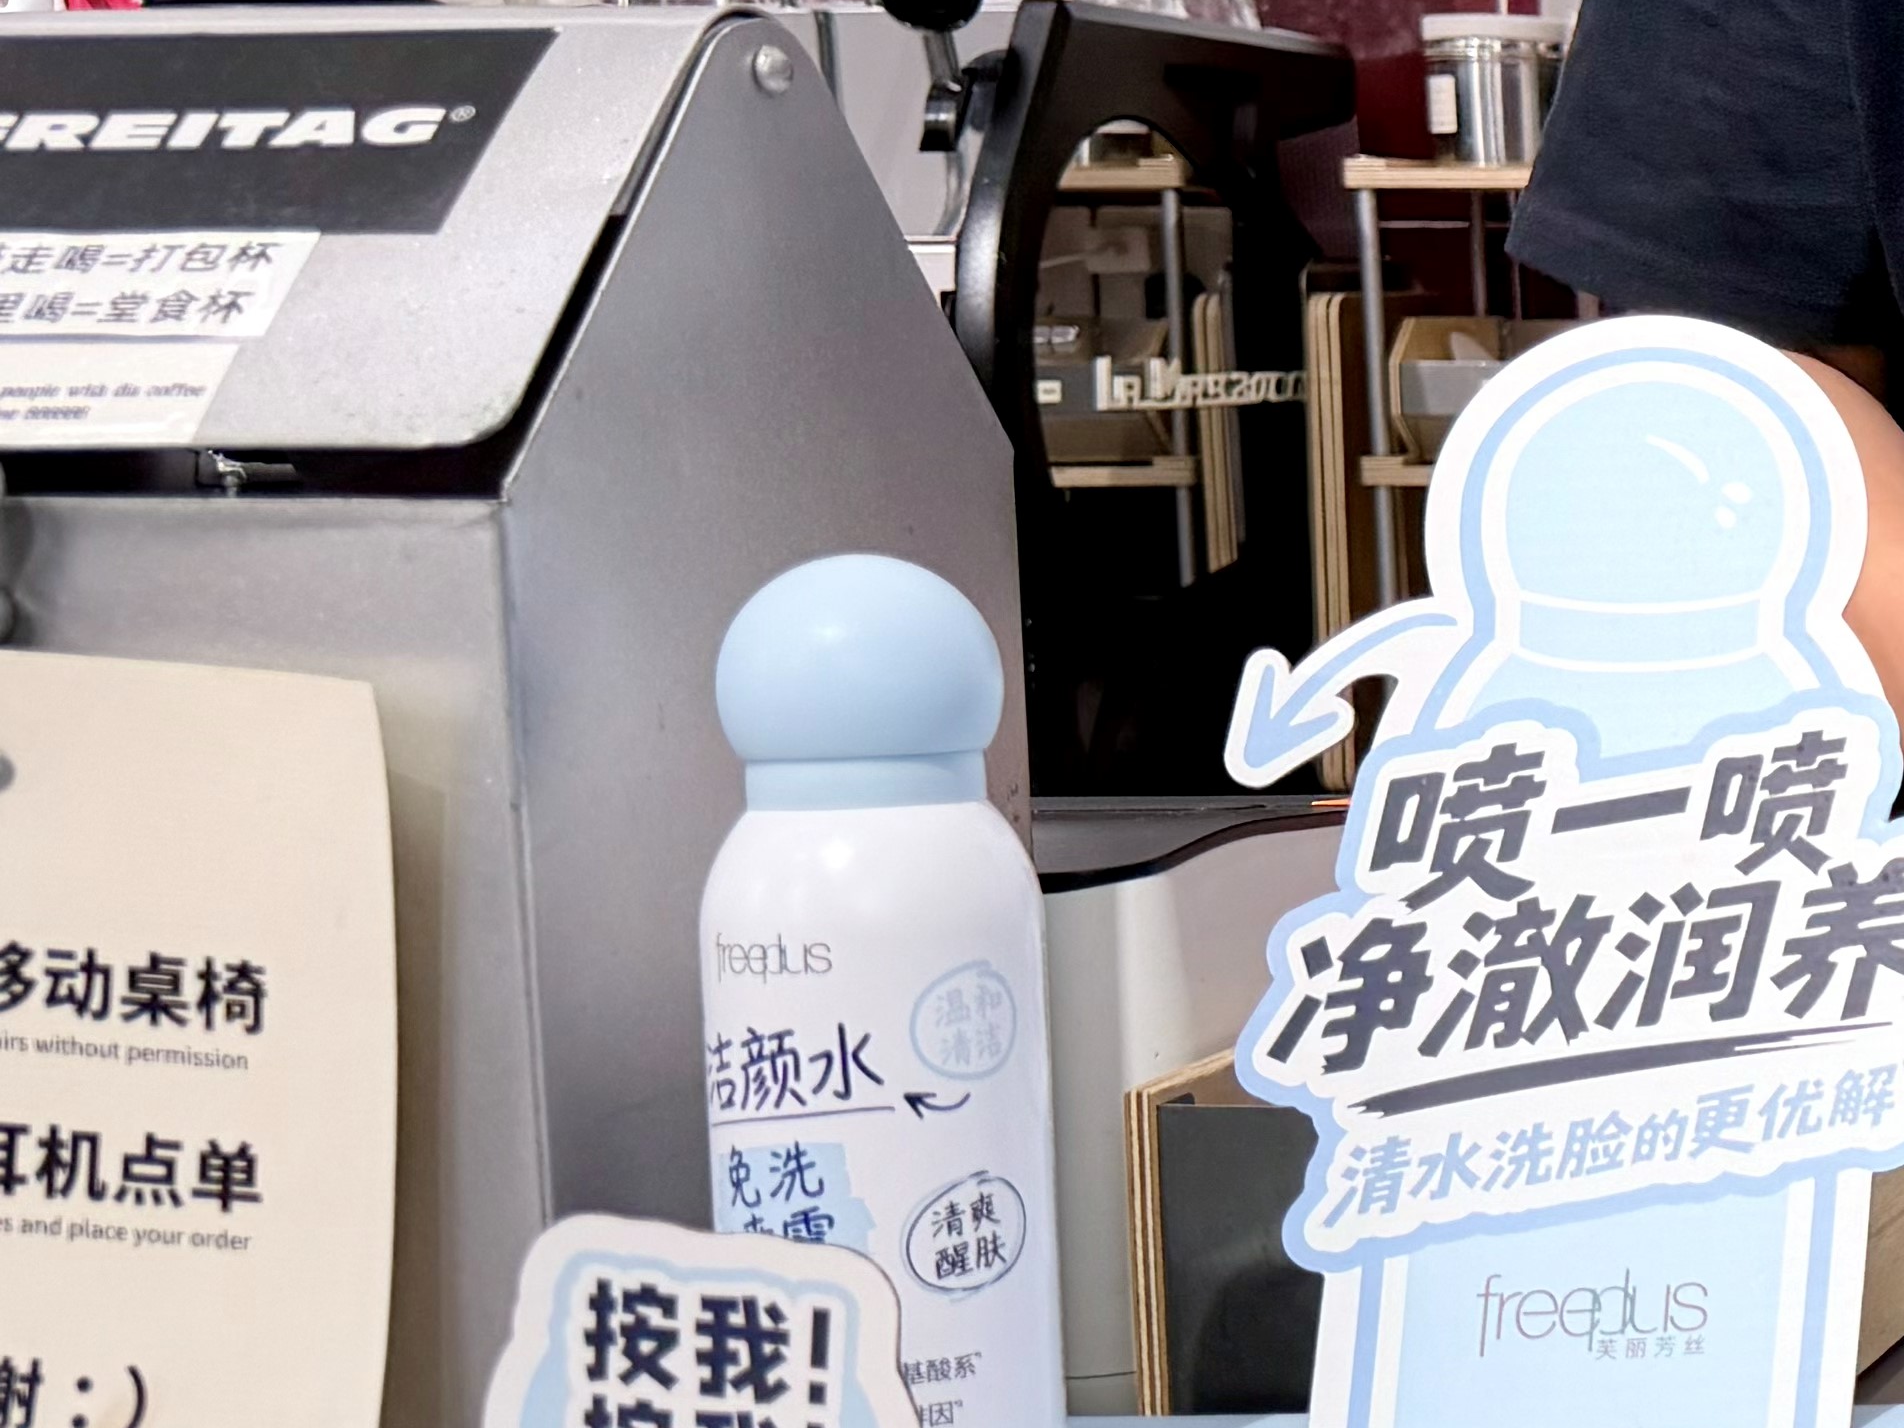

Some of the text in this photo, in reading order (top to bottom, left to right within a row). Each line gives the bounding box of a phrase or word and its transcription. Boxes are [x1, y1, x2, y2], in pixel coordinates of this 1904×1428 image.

[0, 104, 476, 152] REITAG®
[0, 241, 285, 274] 走喝=打包杯
[1367, 730, 1849, 912] 喷一喷
[716, 933, 833, 984] freeplus
[35, 1036, 120, 1059] without
[125, 1046, 249, 1070] permission
[707, 1022, 884, 1111] 洁颜水
[1323, 1061, 1898, 1230] 清水洗脸的更优解
[728, 1140, 825, 1208] 免洗
[21, 1215, 62, 1235] and
[66, 1217, 128, 1242] place
[133, 1227, 183, 1247] your
[189, 1229, 252, 1251] order
[932, 1192, 1000, 1238] 清爽
[935, 1232, 1007, 1281] 醒肤
[1477, 1268, 1708, 1357] freeplus
[582, 1277, 831, 1405] 按我！
[1596, 1335, 1705, 1360] 芙丽芳丝
